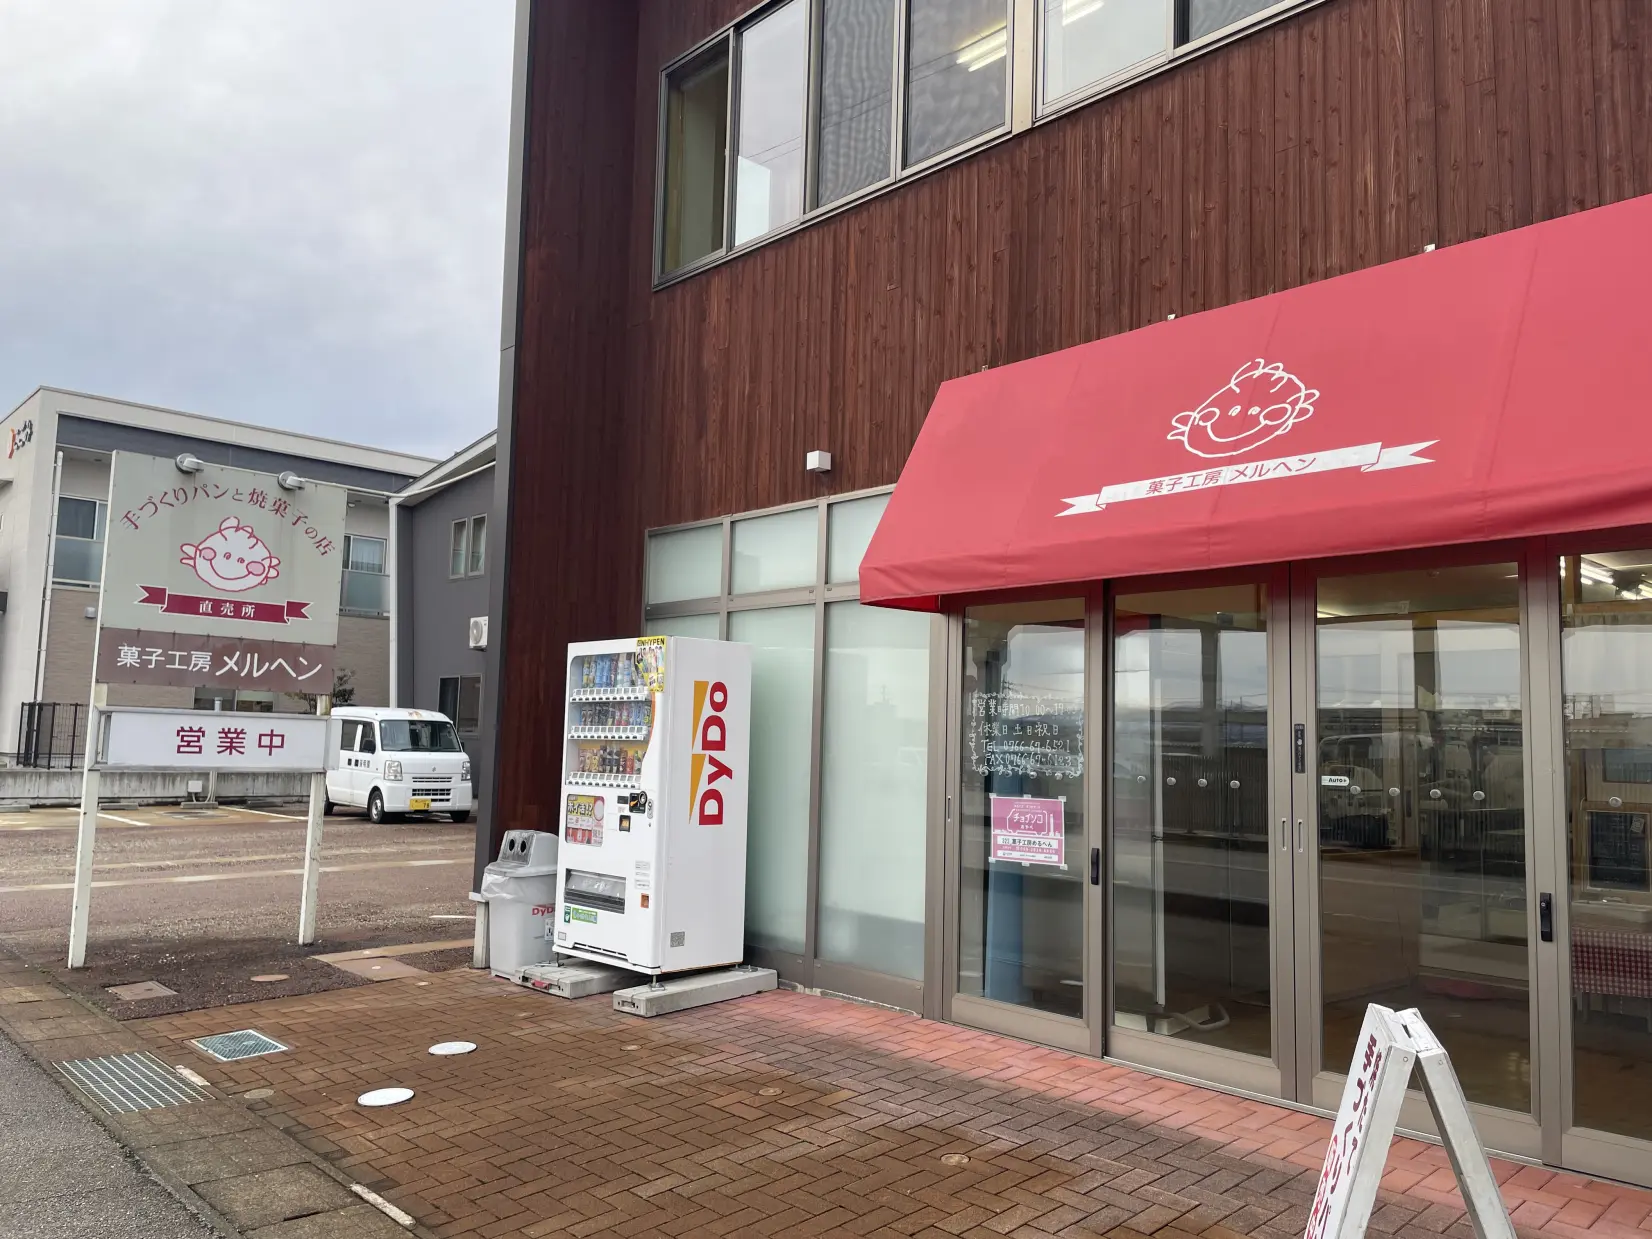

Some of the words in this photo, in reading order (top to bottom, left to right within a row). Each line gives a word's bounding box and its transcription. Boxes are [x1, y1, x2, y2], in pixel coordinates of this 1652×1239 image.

[1145, 469, 1224, 495] 菓子工房
[1229, 457, 1317, 483] メルヘン
[120, 484, 335, 556] 手づくりパンと焼菓子の店
[199, 600, 256, 618] 直売所
[116, 643, 213, 673] 菓子工房
[215, 651, 323, 680] メルヘン
[176, 726, 285, 757] 営業中
[977, 720, 1008, 737] 休業日
[698, 681, 733, 826] DyDo
[1013, 812, 1044, 824] チョイソコ
[531, 906, 556, 917] DyD
